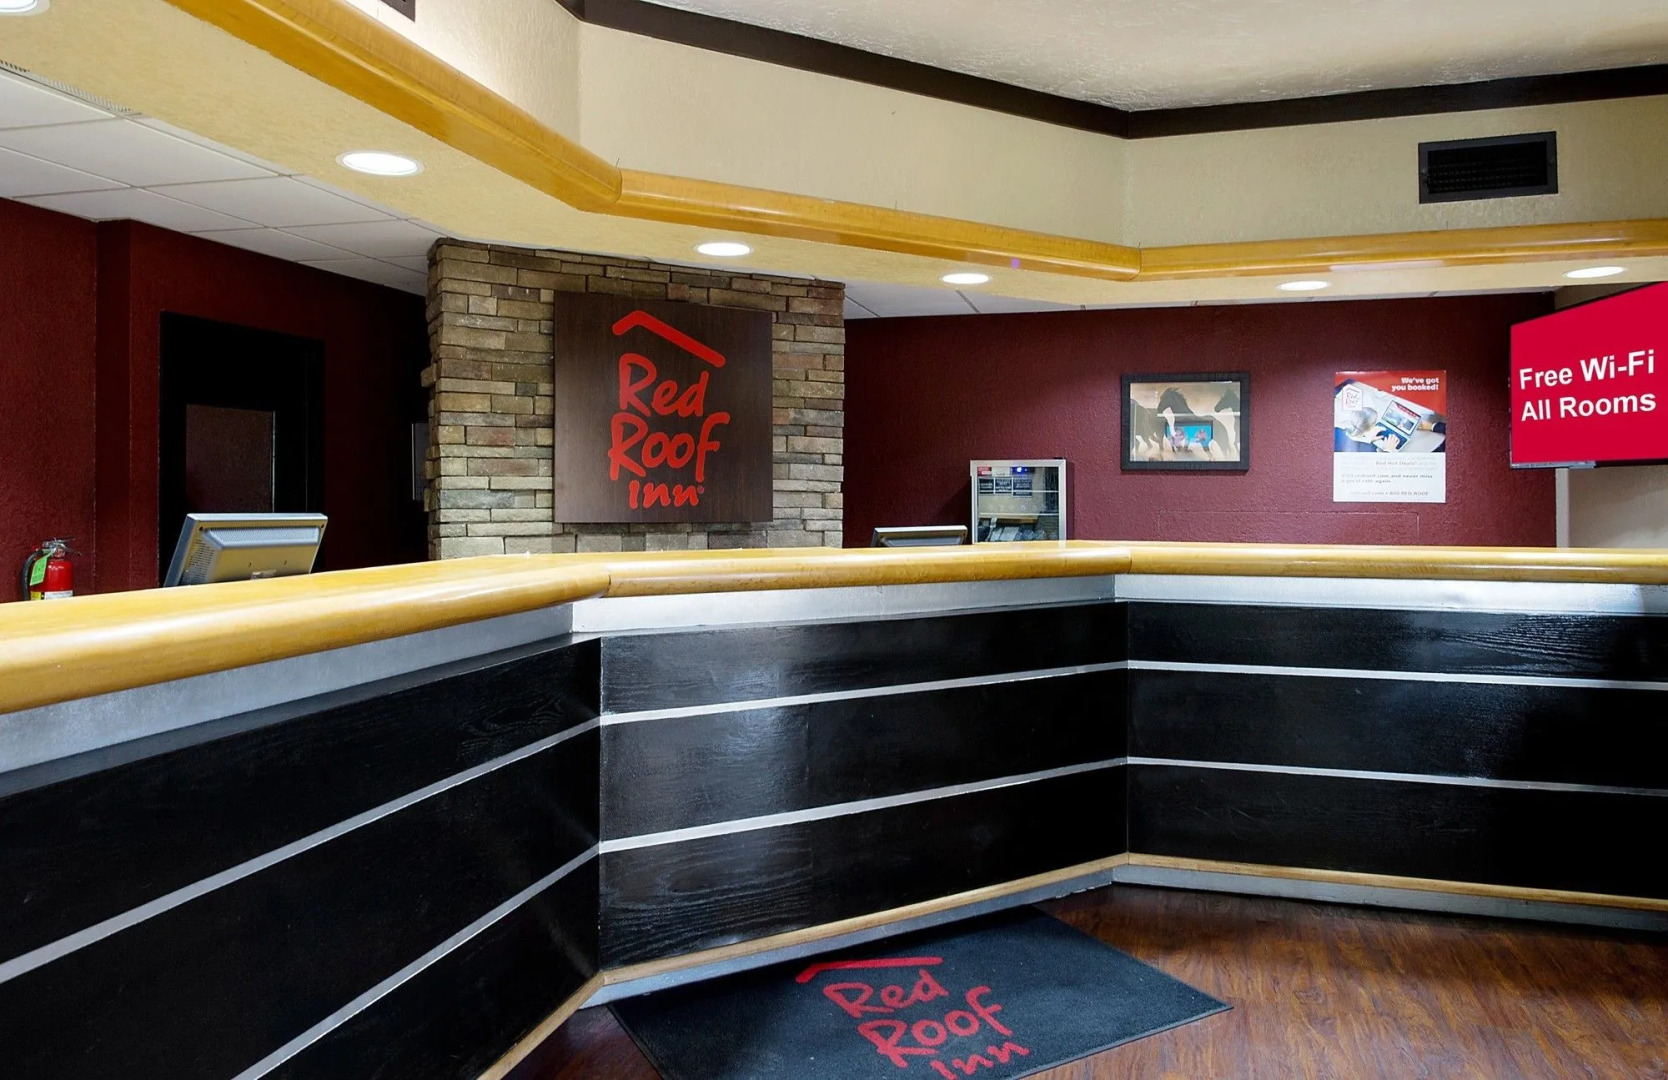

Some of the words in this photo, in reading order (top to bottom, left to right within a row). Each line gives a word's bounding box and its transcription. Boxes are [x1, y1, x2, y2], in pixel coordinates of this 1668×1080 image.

[619, 353, 709, 417] Red
[1426, 377, 1439, 385] got
[1519, 367, 1573, 390] Free
[1580, 349, 1655, 382] Wi-Fi
[1521, 398, 1551, 421] All
[1559, 393, 1657, 419] Rooms
[607, 411, 730, 483] Roof
[822, 968, 949, 1019] Red
[857, 985, 1013, 1069] Roof
